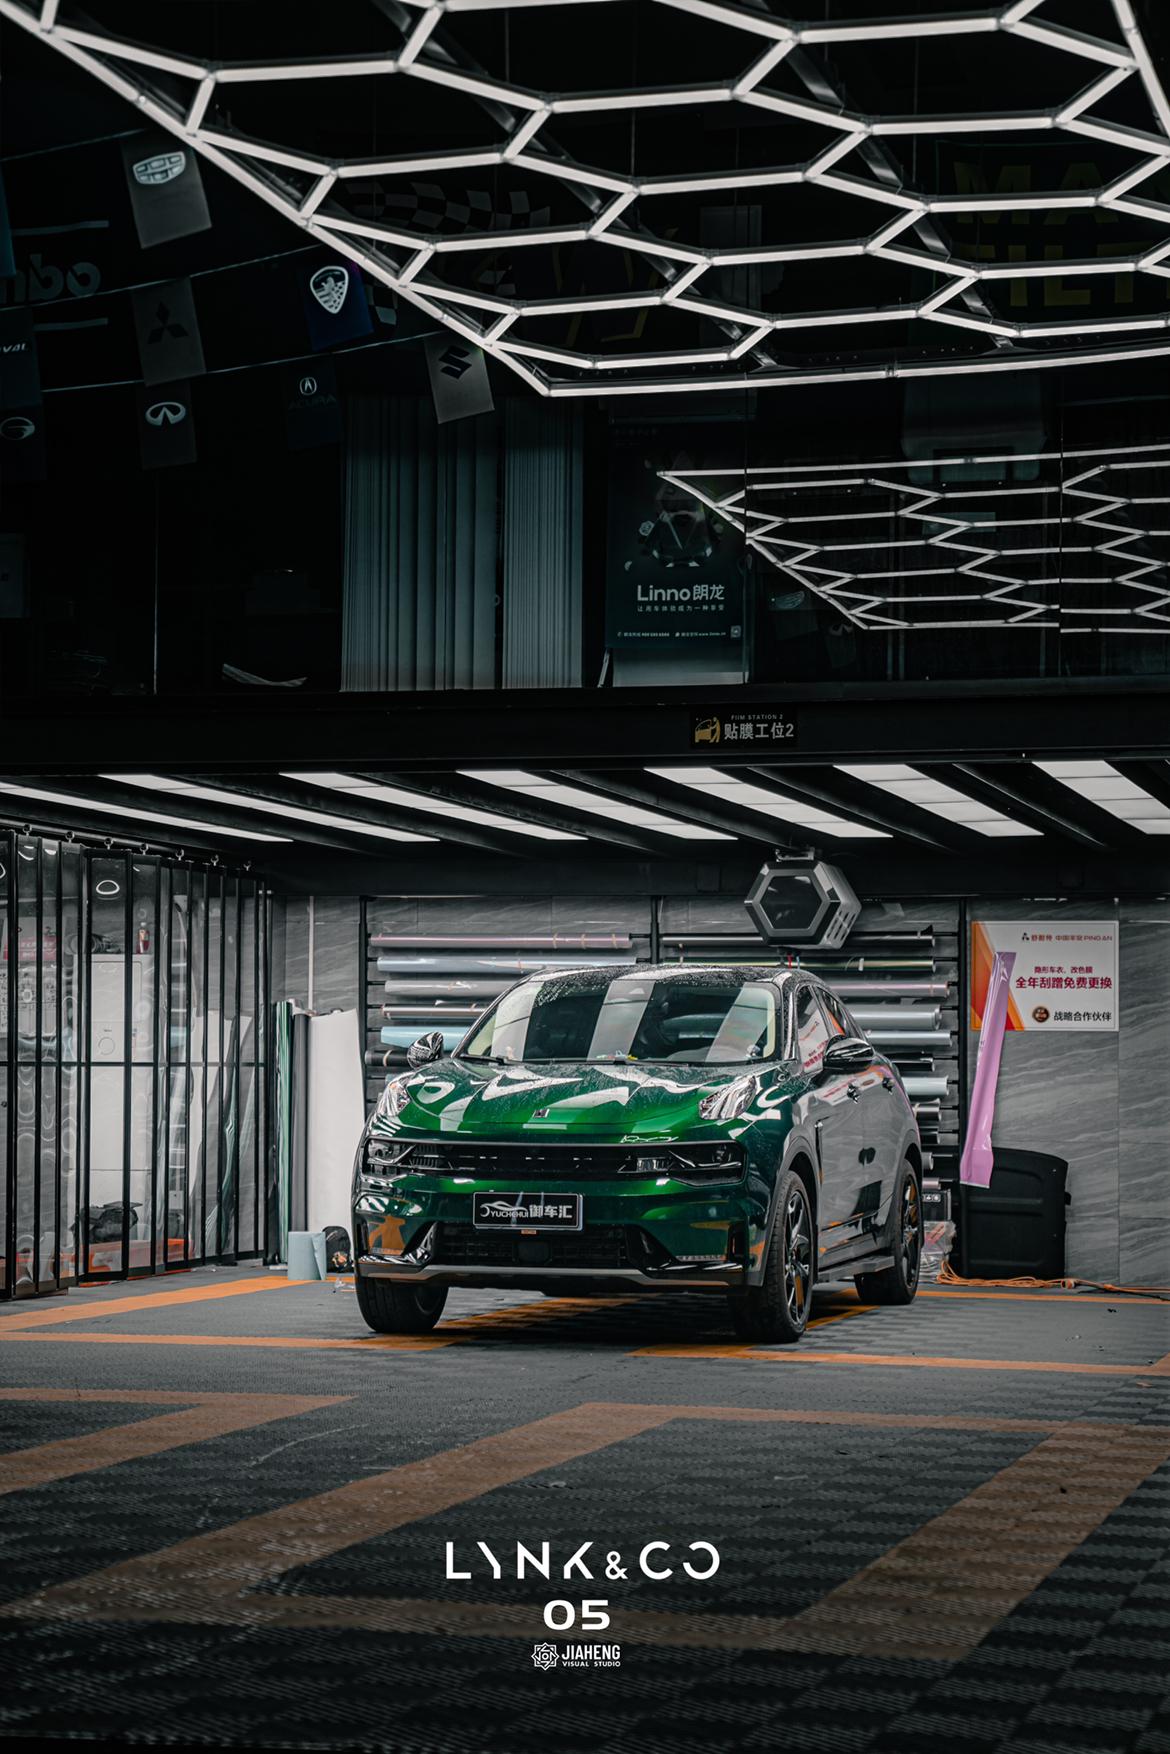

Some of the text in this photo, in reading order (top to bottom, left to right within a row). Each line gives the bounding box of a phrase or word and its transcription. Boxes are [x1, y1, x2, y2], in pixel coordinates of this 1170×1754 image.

[637, 584, 725, 601] Linno 朗龙
[724, 722, 794, 740] 贴膜工位2
[1015, 977, 1112, 989] 全年刮蹭免费更换
[1053, 1011, 1112, 1021] 战略合作伙伴
[529, 1204, 573, 1219] 御车汇
